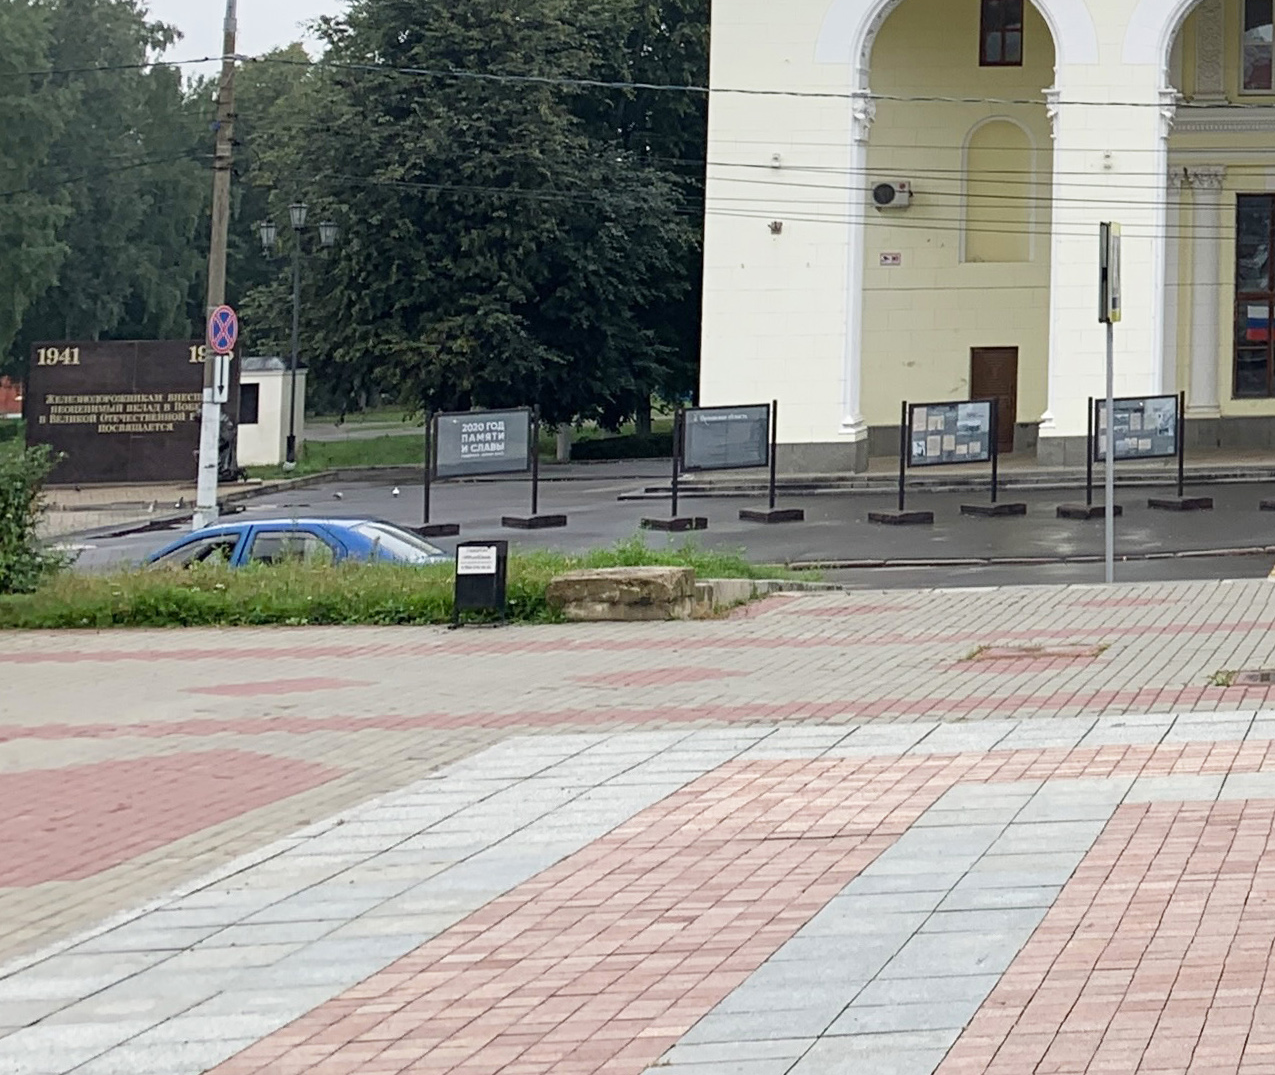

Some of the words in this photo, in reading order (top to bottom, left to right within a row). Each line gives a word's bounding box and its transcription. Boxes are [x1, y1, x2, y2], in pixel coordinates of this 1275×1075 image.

[37, 347, 80, 365] 1941
[462, 422, 485, 432] 2020
[486, 421, 505, 431] ГОД
[461, 431, 505, 443] ПАМЯТИ
[461, 444, 468, 453] И
[470, 442, 505, 452] СЛАВЫ
